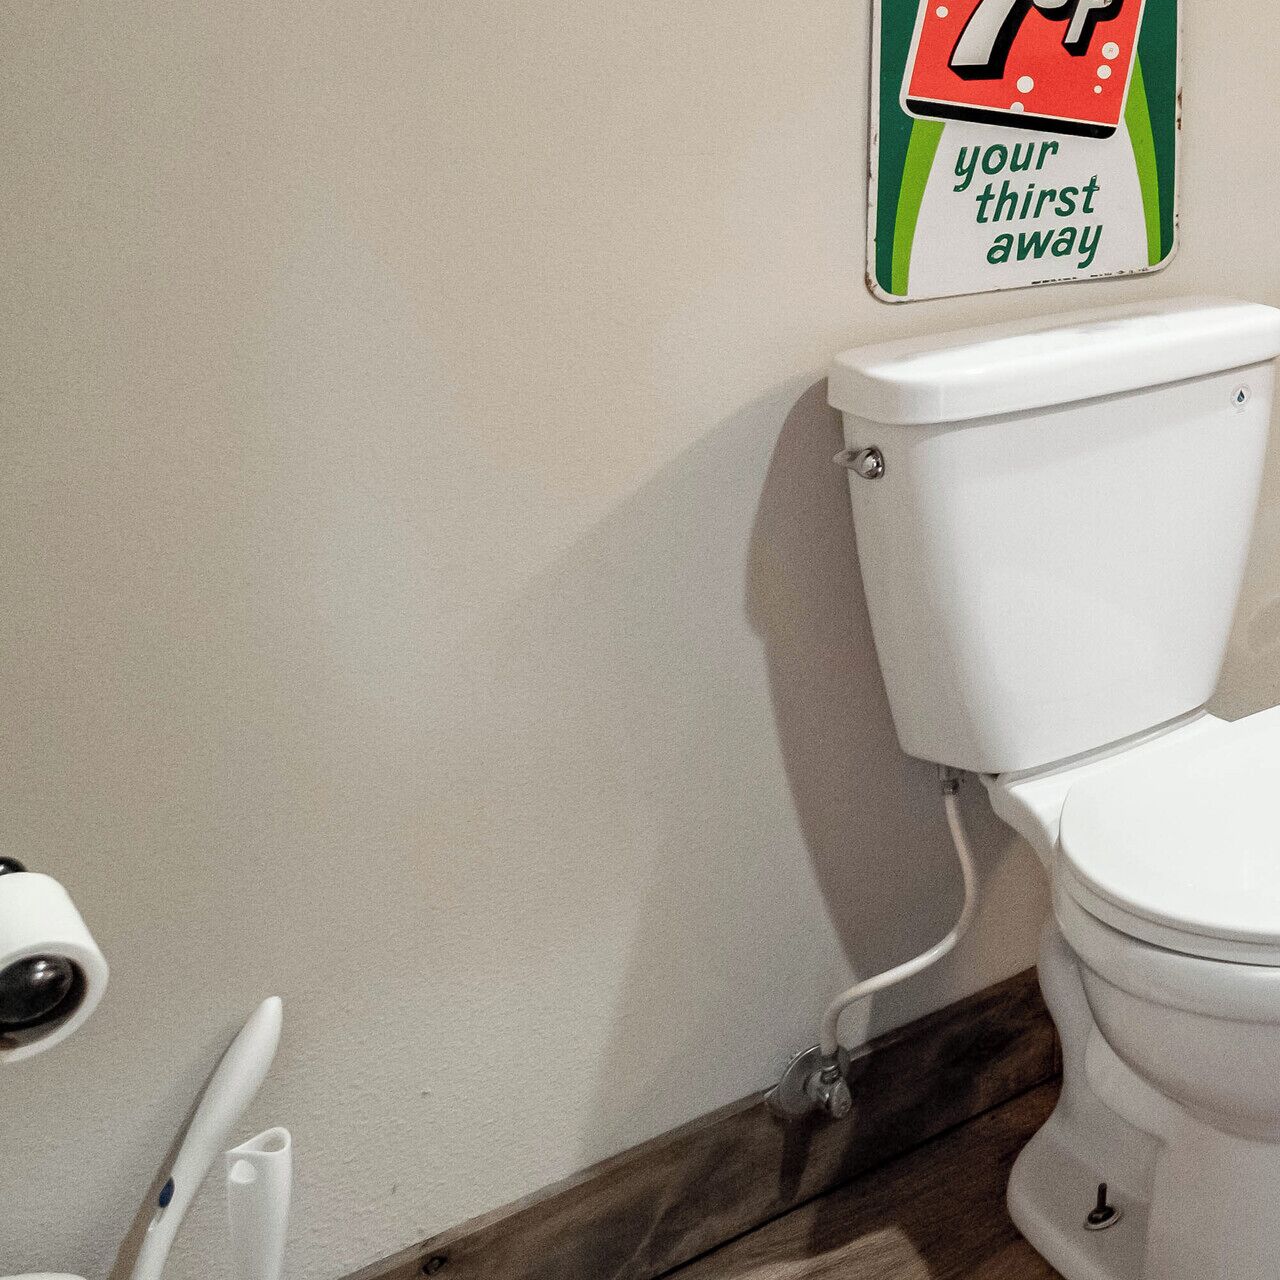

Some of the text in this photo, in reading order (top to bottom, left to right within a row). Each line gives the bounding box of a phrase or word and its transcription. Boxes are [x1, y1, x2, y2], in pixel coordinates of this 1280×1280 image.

[953, 140, 1060, 193] your
[975, 174, 1101, 224] thirst
[986, 224, 1104, 269] away
